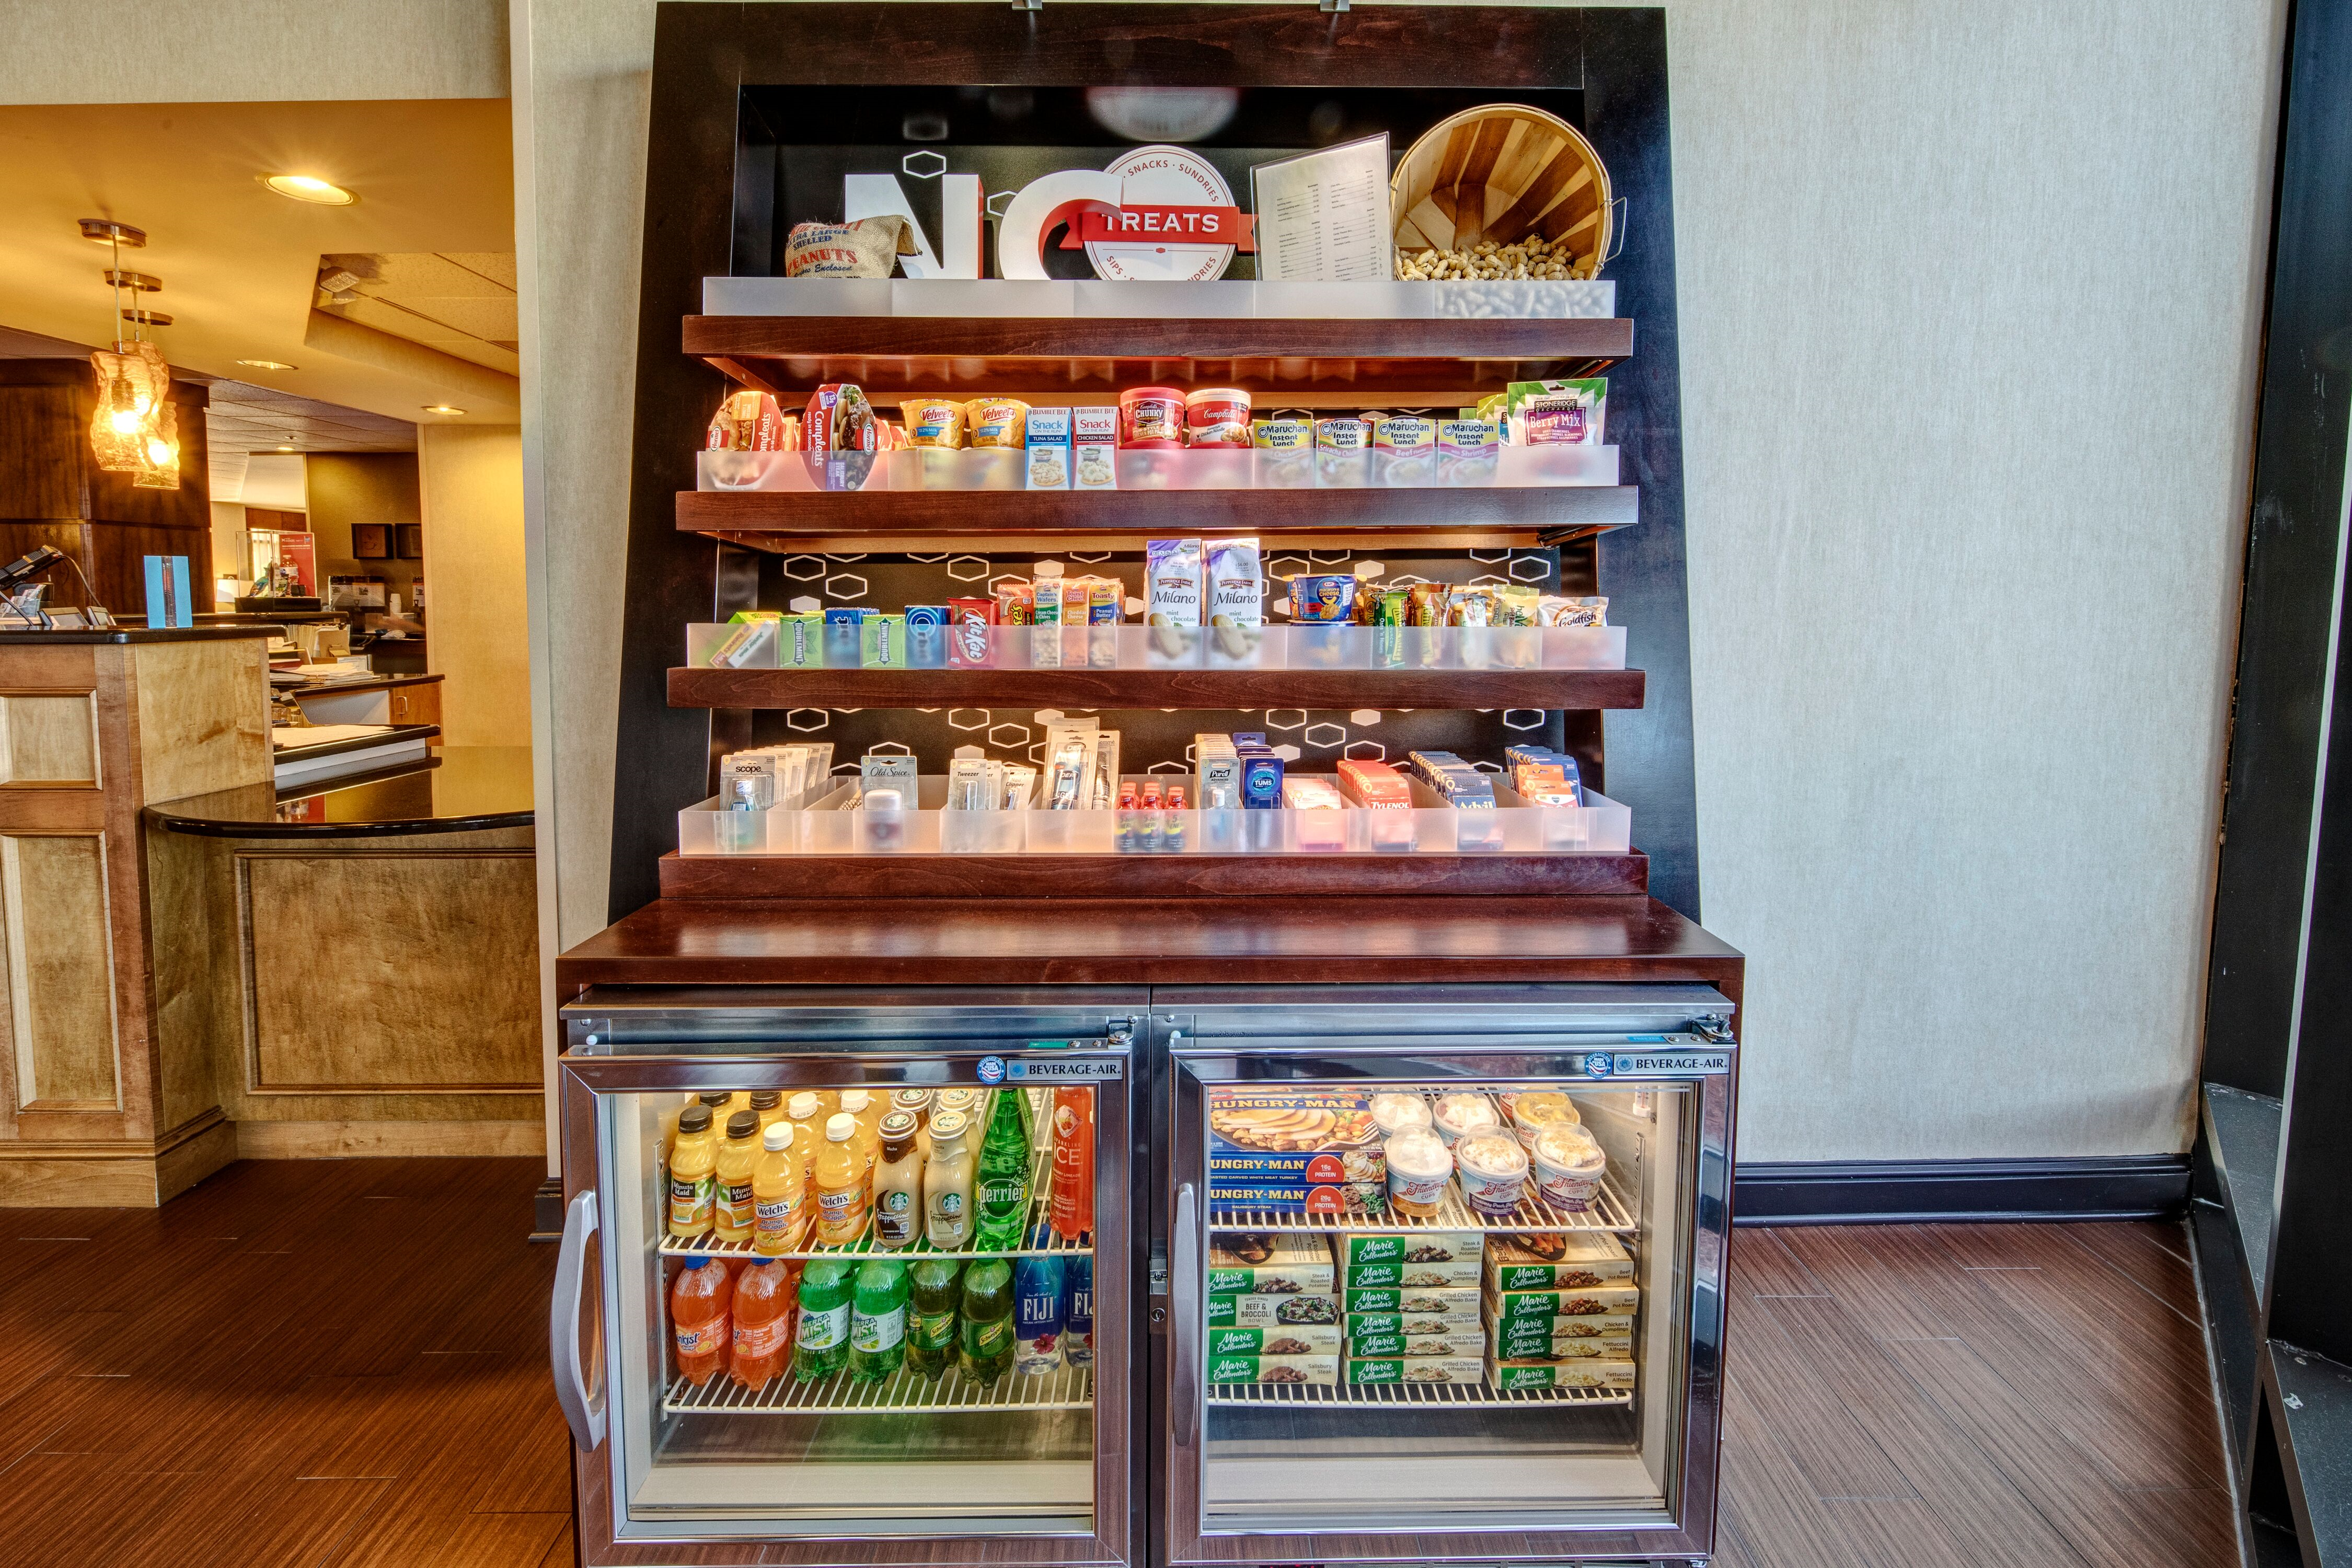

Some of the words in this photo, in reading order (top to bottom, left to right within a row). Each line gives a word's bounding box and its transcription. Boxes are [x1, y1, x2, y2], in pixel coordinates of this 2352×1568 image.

[1128, 160, 1168, 176] SNACKS
[1179, 164, 1219, 202] SUNDRIES
[1102, 212, 1219, 233] TREATS
[793, 236, 832, 250] SHELLED
[1106, 256, 1123, 274] SIPS
[1187, 257, 1216, 281] NDRIES
[922, 409, 955, 421] Velveeta
[982, 408, 1015, 420] Velveeta
[1204, 409, 1236, 419] Campbell's
[1032, 420, 1063, 429] Snack
[1080, 419, 1111, 429] Snack
[1331, 422, 1370, 431] Maruchan
[1530, 416, 1559, 428] Berry
[1560, 414, 1581, 426] Mix
[1452, 424, 1494, 432] Maruchan
[814, 410, 826, 466] Compleats
[1461, 448, 1486, 457] Shrimp
[1151, 591, 1196, 605] Milano
[1214, 591, 1258, 606] Milano
[1559, 613, 1597, 627] Goldfish
[794, 622, 803, 662] DOUBLEMINT
[735, 765, 761, 774] scope
[870, 766, 885, 776] Old
[887, 767, 907, 777] Spice
[1636, 1058, 1724, 1069] BEVERAGE-AIR
[1029, 1065, 1117, 1075] BEVERAGE-AIR
[1210, 1100, 1356, 1109] HUNGRY-MAN
[1054, 1136, 1081, 1147] SPARKLING
[1054, 1142, 1080, 1165] ICE
[1211, 1160, 1305, 1170] UNGRY-MAN
[673, 1181, 694, 1190] Minute
[1553, 1174, 1593, 1189] Friendly's
[1406, 1181, 1444, 1196] Friendly's
[735, 1192, 753, 1201] Maid
[819, 1195, 848, 1206] Welch's
[1211, 1190, 1305, 1200] UNGRY-MAN
[757, 1203, 788, 1216] Welch's
[877, 1208, 909, 1224] frappuccino
[930, 1210, 962, 1225] frappuccino
[758, 1222, 788, 1230] Pineapple
[1211, 1273, 1244, 1283] Marie
[1356, 1266, 1392, 1279] Marie
[1511, 1267, 1546, 1279] Marie
[1208, 1281, 1246, 1292] Callender's
[1356, 1275, 1394, 1286] Callender's
[1509, 1276, 1548, 1289] Callender's
[1023, 1297, 1054, 1320] FIJI
[1209, 1302, 1232, 1311] Marie
[802, 1313, 828, 1328] SIERRA
[854, 1318, 875, 1326] SIERRA
[932, 1316, 953, 1335] Schweppes
[801, 1319, 830, 1338] MIST
[853, 1321, 877, 1337] MIST
[981, 1326, 1002, 1344] Schweppes
[1358, 1362, 1393, 1374] Marie
[1357, 1370, 1396, 1382] Callender's
[1511, 1370, 1546, 1381] Marie
[1509, 1378, 1548, 1389] Callender's
